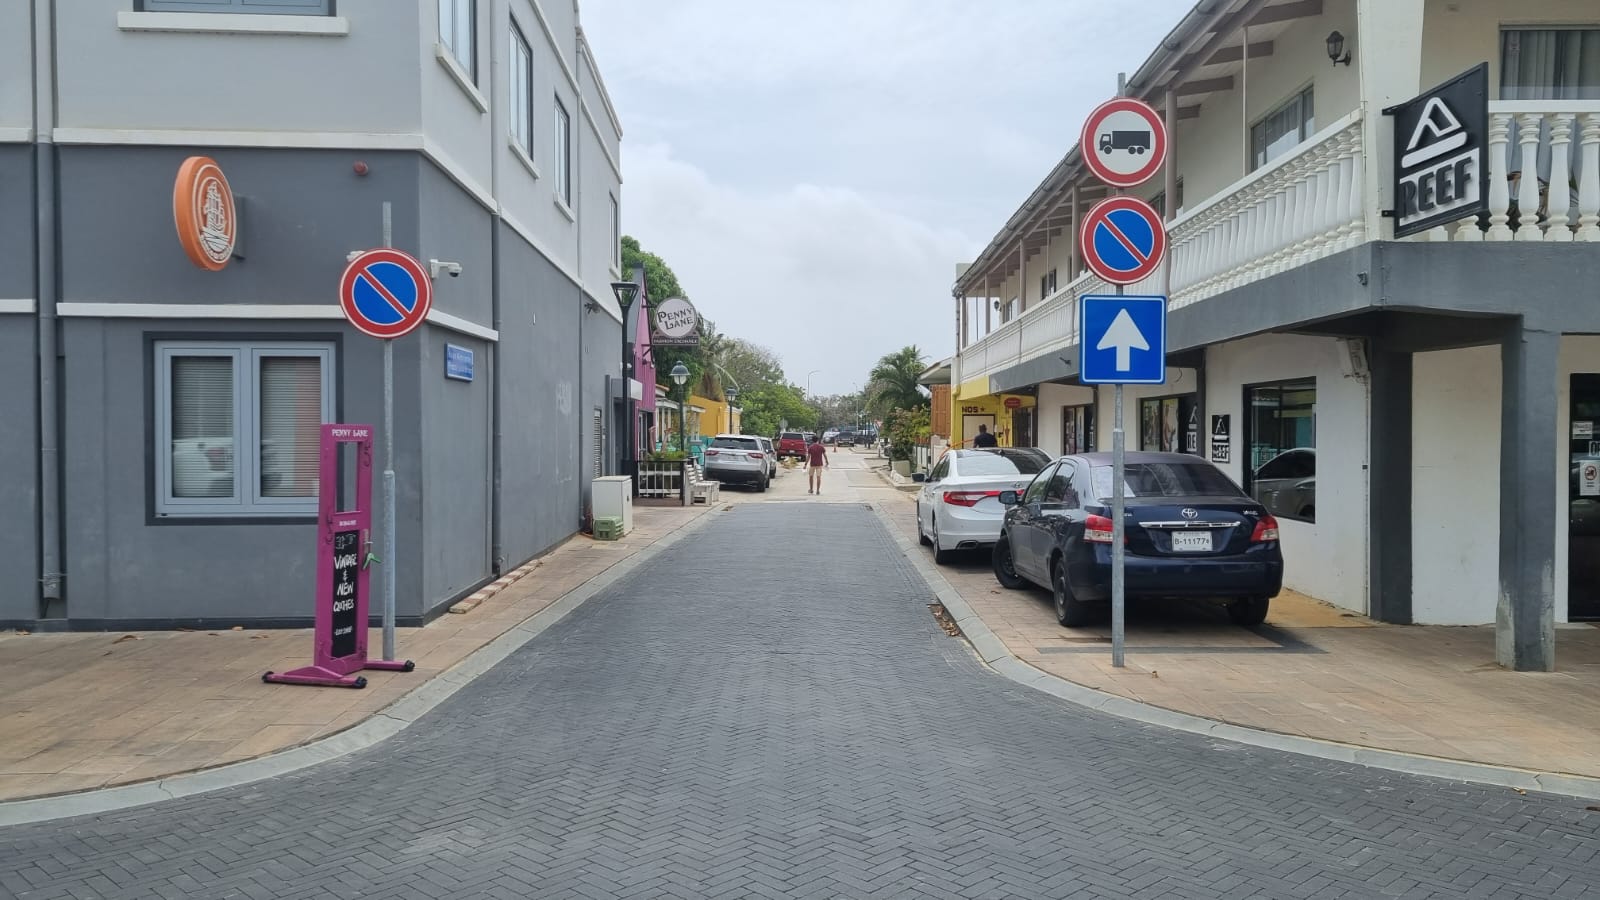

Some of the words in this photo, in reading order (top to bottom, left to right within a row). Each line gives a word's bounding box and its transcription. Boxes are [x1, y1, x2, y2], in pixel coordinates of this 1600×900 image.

[1400, 155, 1474, 218] REEF
[656, 308, 694, 323] PENNY
[664, 316, 694, 330] LANE
[331, 429, 351, 437] PENNY
[352, 429, 368, 437] LANE
[334, 553, 358, 570] VINTAGE
[337, 582, 354, 596] NEW
[333, 599, 355, 612] CLOTHES
